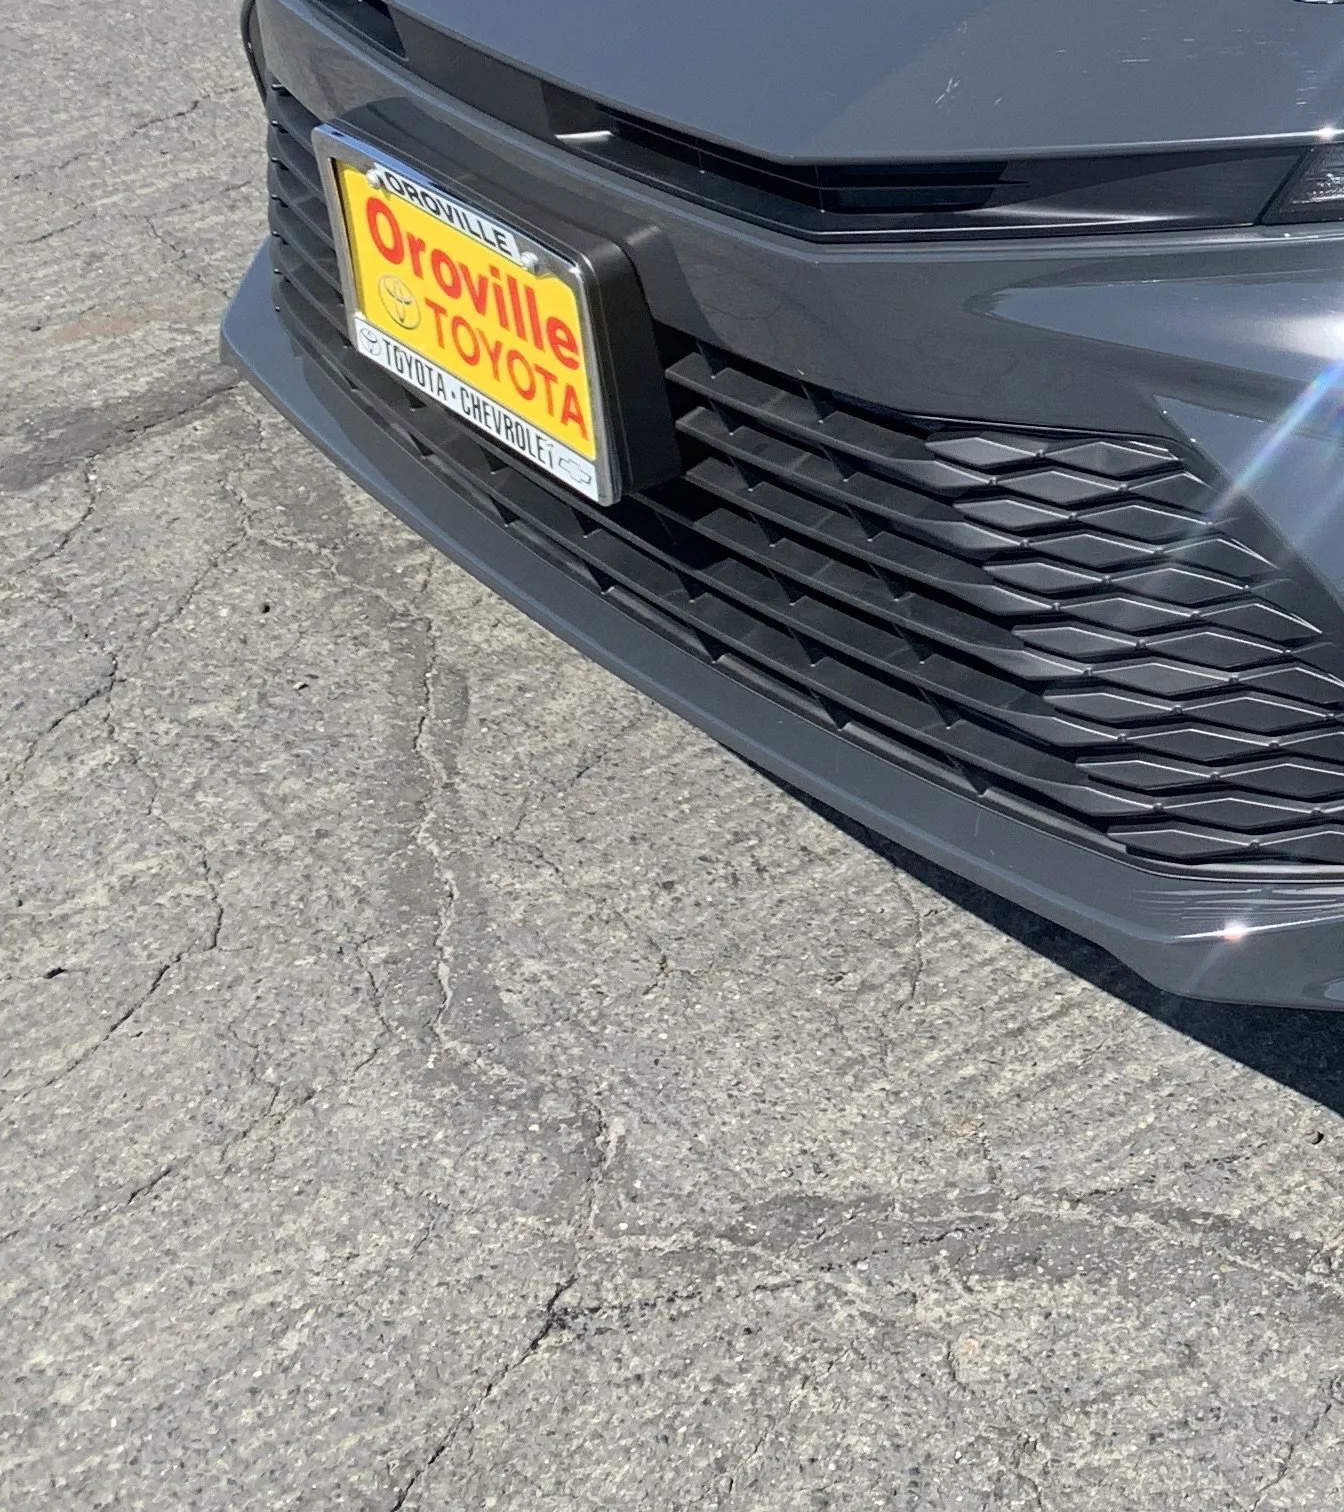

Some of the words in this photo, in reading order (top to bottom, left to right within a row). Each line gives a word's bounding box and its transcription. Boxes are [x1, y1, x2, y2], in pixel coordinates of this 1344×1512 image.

[384, 171, 513, 257] OROVILLE
[366, 196, 582, 371] Oroville
[382, 339, 447, 402] TOYOTA
[460, 386, 555, 469] CHEVROLET
[425, 297, 590, 441] TOYOTA
